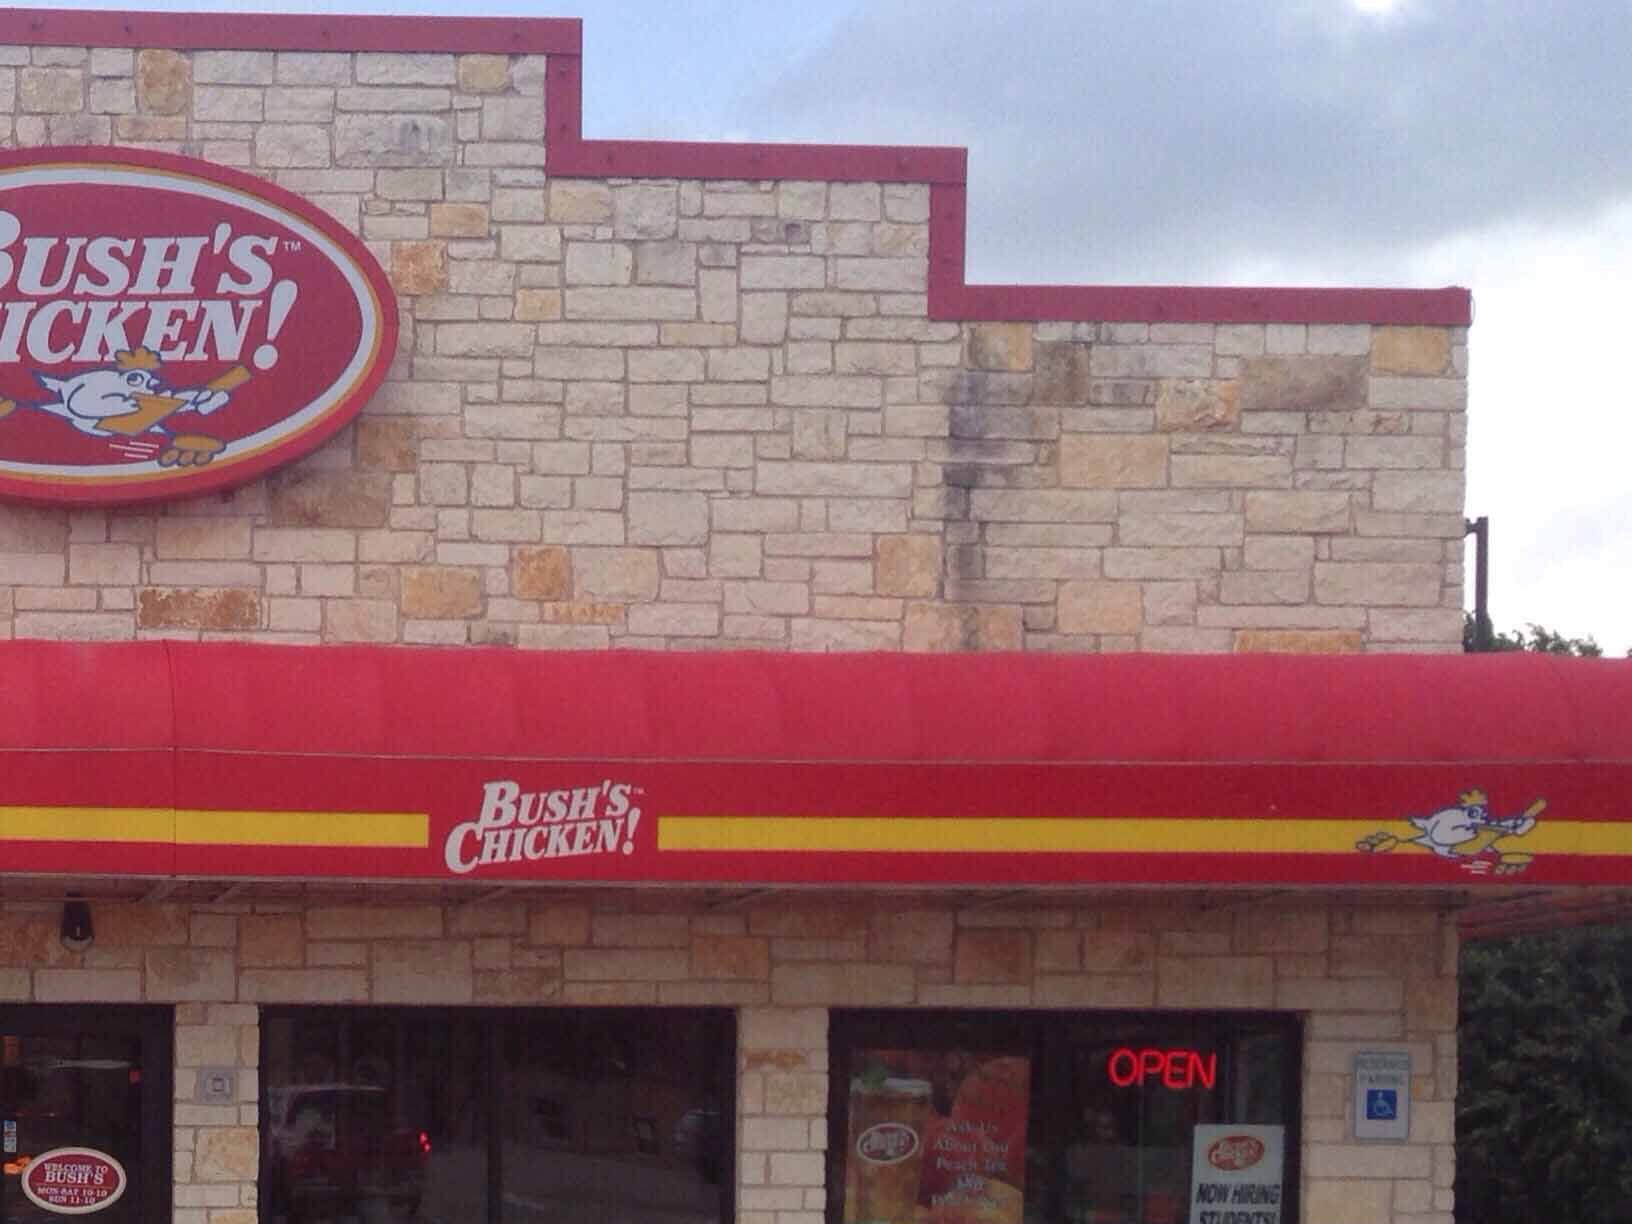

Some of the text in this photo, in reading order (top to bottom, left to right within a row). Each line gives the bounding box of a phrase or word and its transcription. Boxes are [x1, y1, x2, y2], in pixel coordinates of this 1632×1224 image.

[479, 779, 632, 829] BUSH'S
[444, 807, 641, 874] CHICKEN!
[1106, 1046, 1217, 1090] OPEN
[43, 1162, 109, 1174] WELCOME TO
[44, 1171, 105, 1185] BUSH'S
[48, 1196, 96, 1205] SUN 11-10
[1195, 1183, 1281, 1205] NOW HIRING
